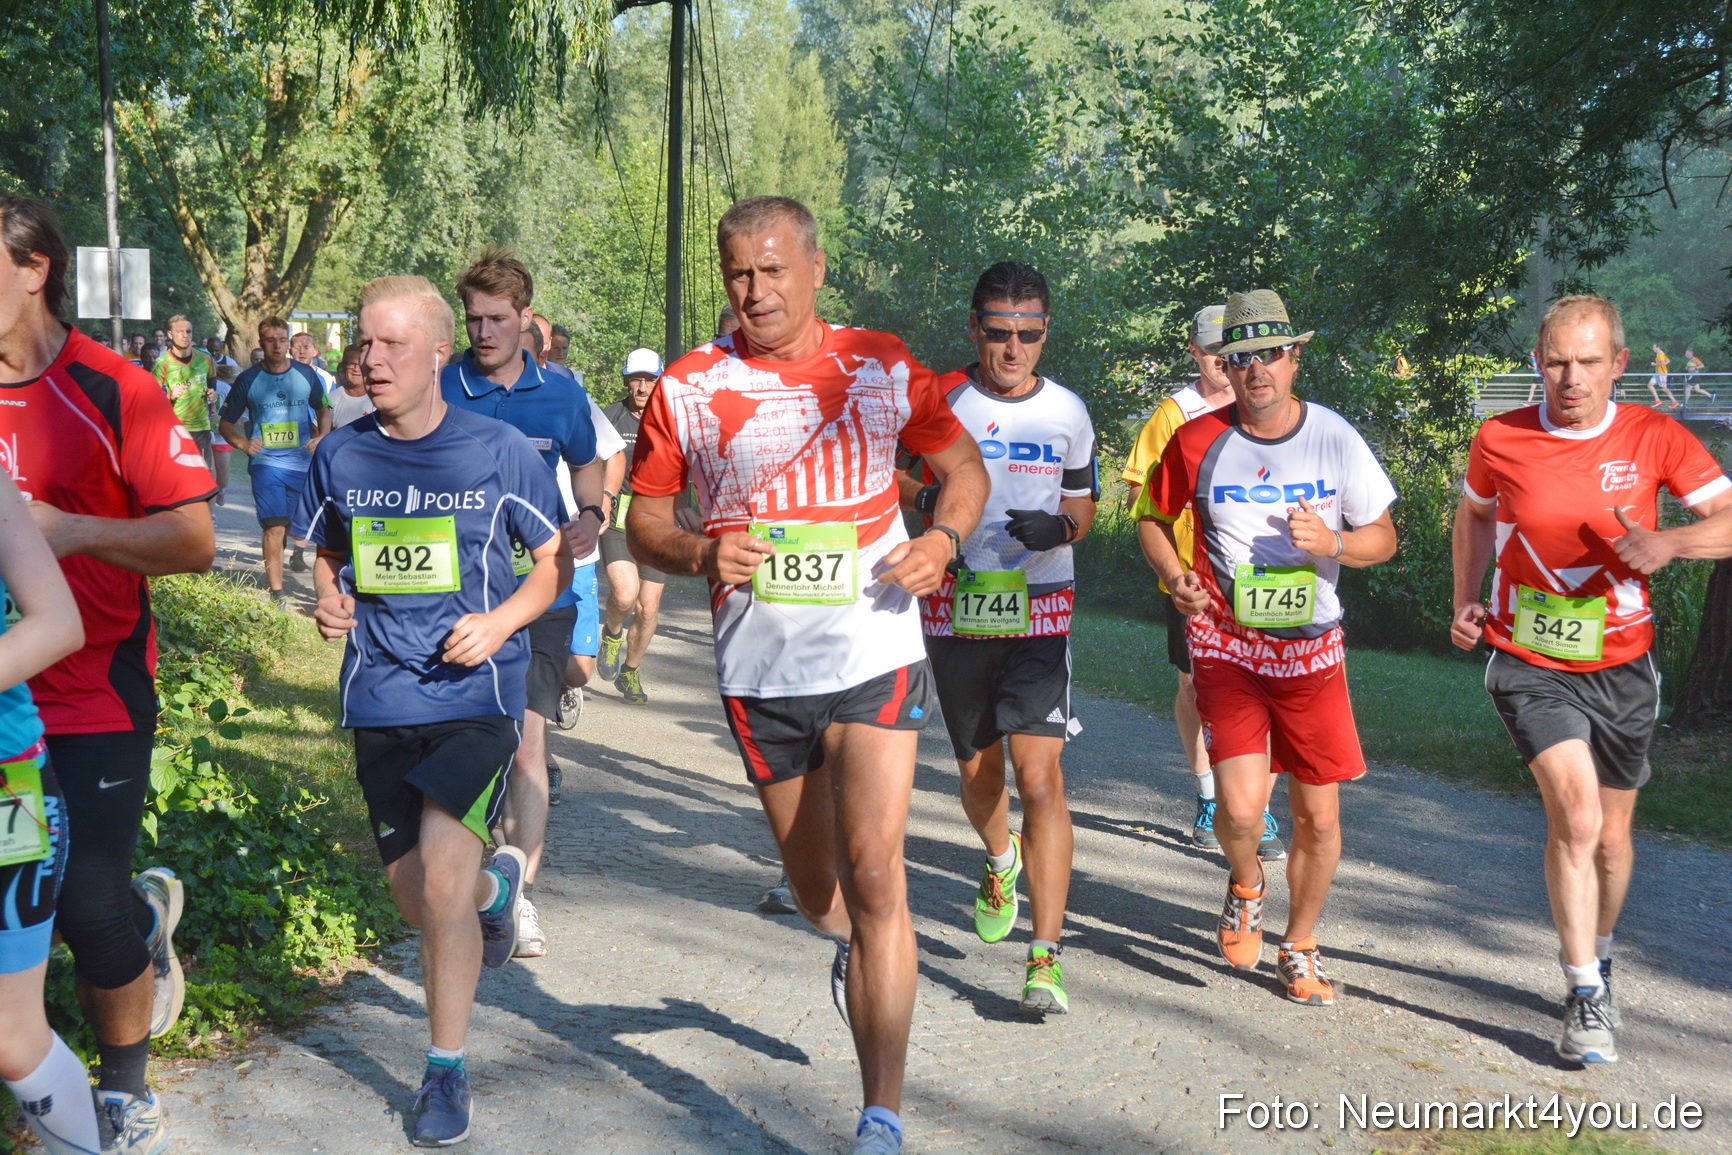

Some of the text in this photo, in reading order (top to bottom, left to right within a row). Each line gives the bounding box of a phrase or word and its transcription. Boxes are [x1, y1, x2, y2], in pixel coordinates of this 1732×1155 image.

[267, 431, 294, 441] 1770
[754, 427, 788, 438] 52.01
[755, 443, 790, 456] 26.22
[424, 490, 486, 510] POLES
[375, 546, 433, 572] 492
[764, 554, 844, 582] 1837
[766, 582, 810, 591] Dennerlohr
[961, 593, 1020, 616] 1744
[1246, 587, 1307, 609] 1745
[960, 616, 1020, 625] Herrmann Wolfgang
[1532, 613, 1583, 642] 542
[1534, 635, 1578, 649] Albert Simon
